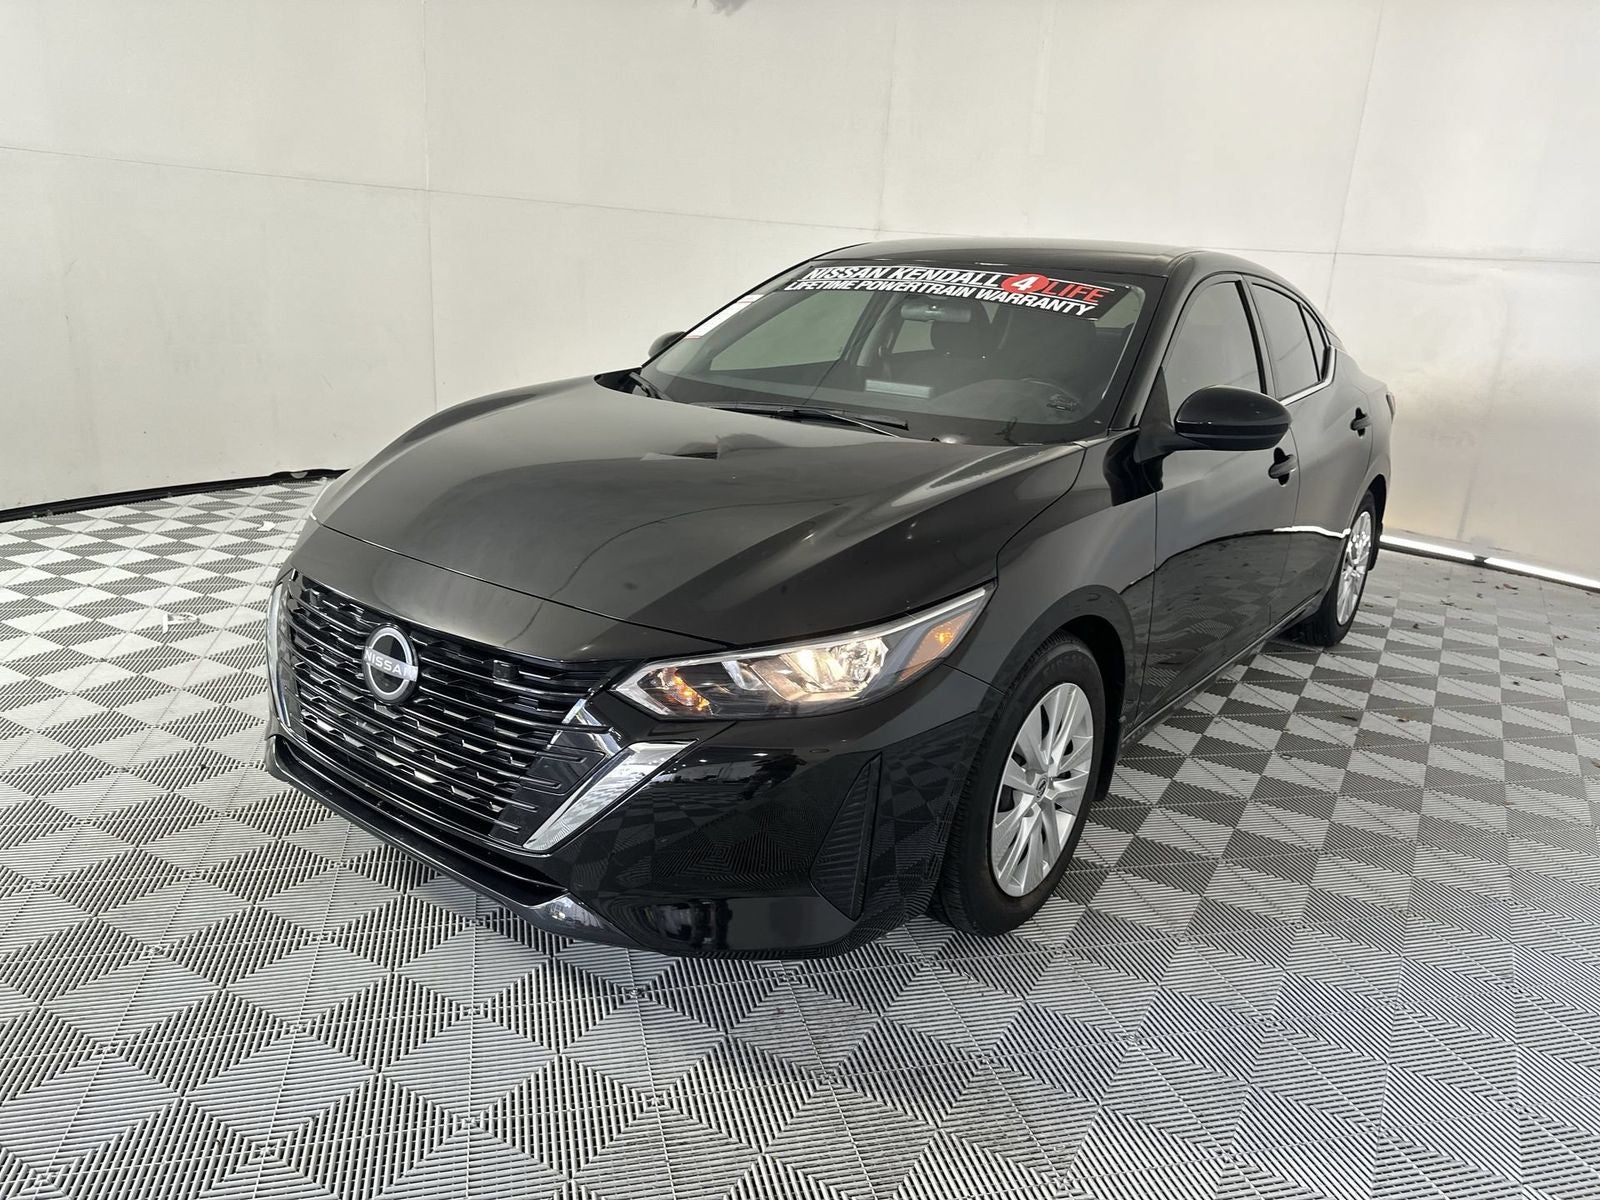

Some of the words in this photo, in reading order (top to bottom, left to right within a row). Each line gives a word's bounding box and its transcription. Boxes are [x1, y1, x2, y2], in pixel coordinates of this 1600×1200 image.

[784, 280, 859, 291] LIFETIME
[854, 280, 976, 298] POWERTRAIN
[974, 289, 1096, 316] WARRANTY
[801, 266, 885, 280] NISSAN
[887, 267, 1001, 288] KENDALL
[1011, 276, 1039, 291] 4
[1042, 281, 1110, 303] LIFE
[364, 649, 417, 680] NISSAN
